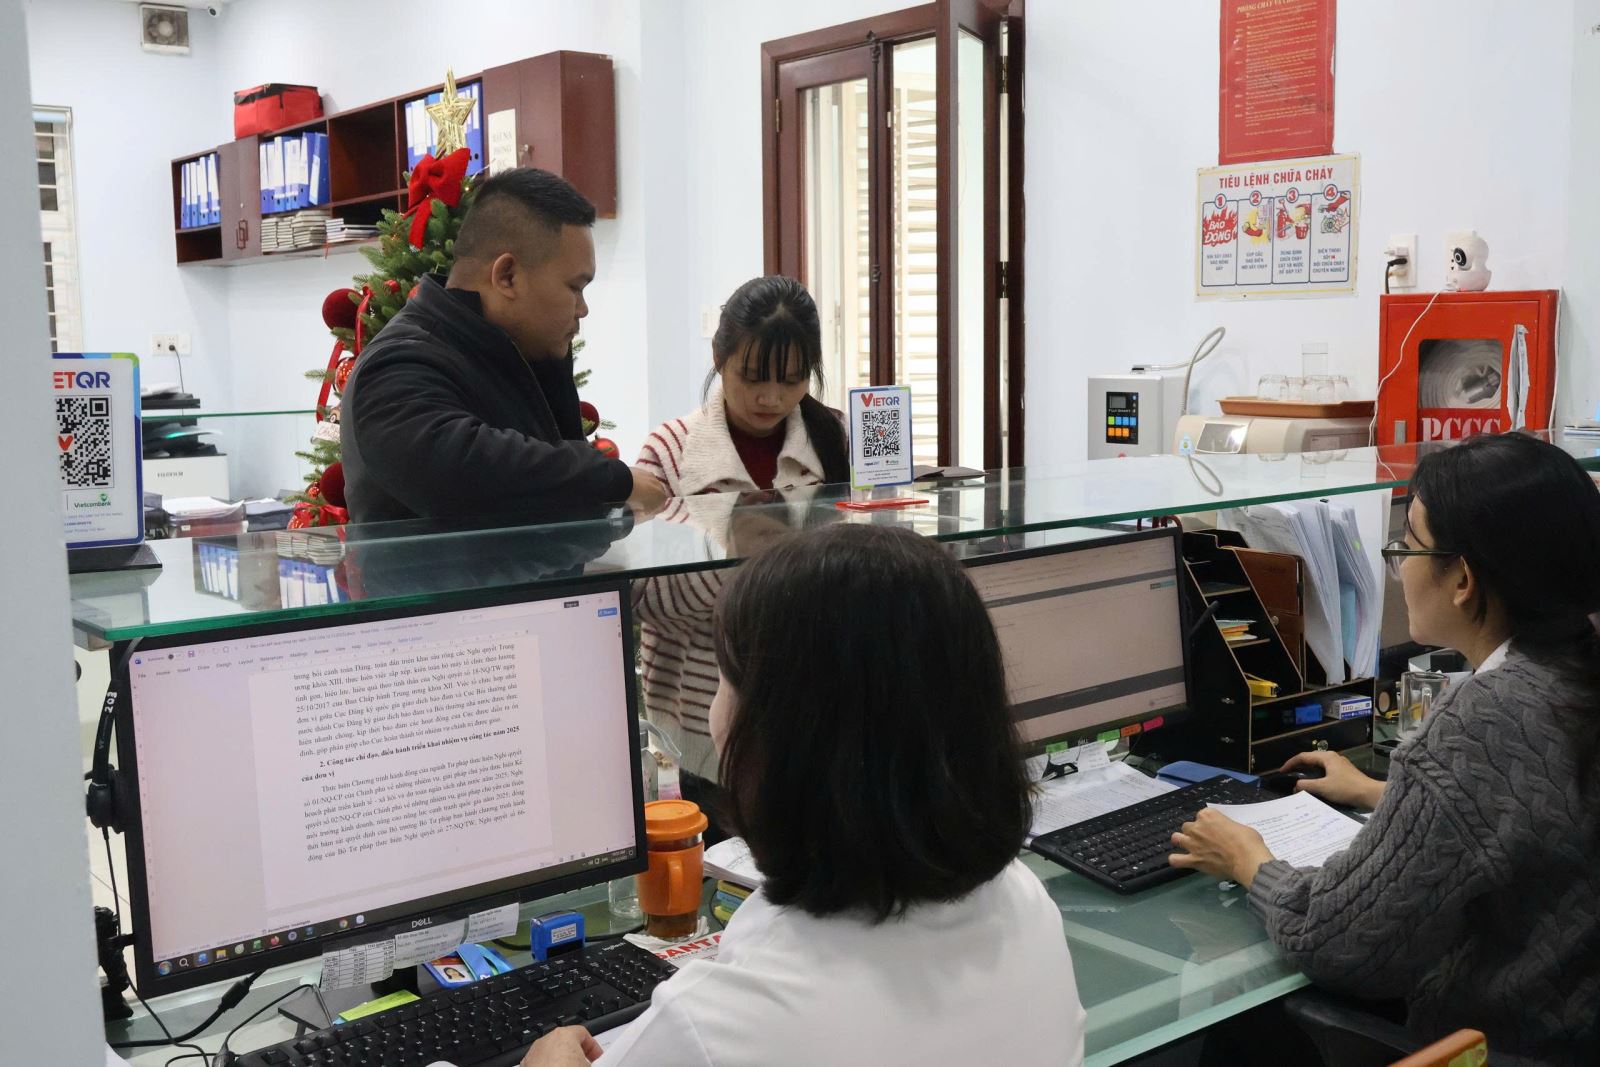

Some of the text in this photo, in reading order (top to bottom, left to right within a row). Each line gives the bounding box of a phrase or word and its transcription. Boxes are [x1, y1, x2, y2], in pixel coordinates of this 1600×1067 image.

[1244, 173, 1270, 188] LỆNH
[1274, 169, 1302, 184] CHỮA
[1306, 165, 1334, 181] CHÁY
[1289, 190, 1296, 200] 3
[1326, 187, 1335, 197] 4
[1217, 196, 1222, 206] 1
[1252, 193, 1260, 203] 2
[861, 393, 900, 408] VIETQR
[411, 917, 432, 928] DELL
